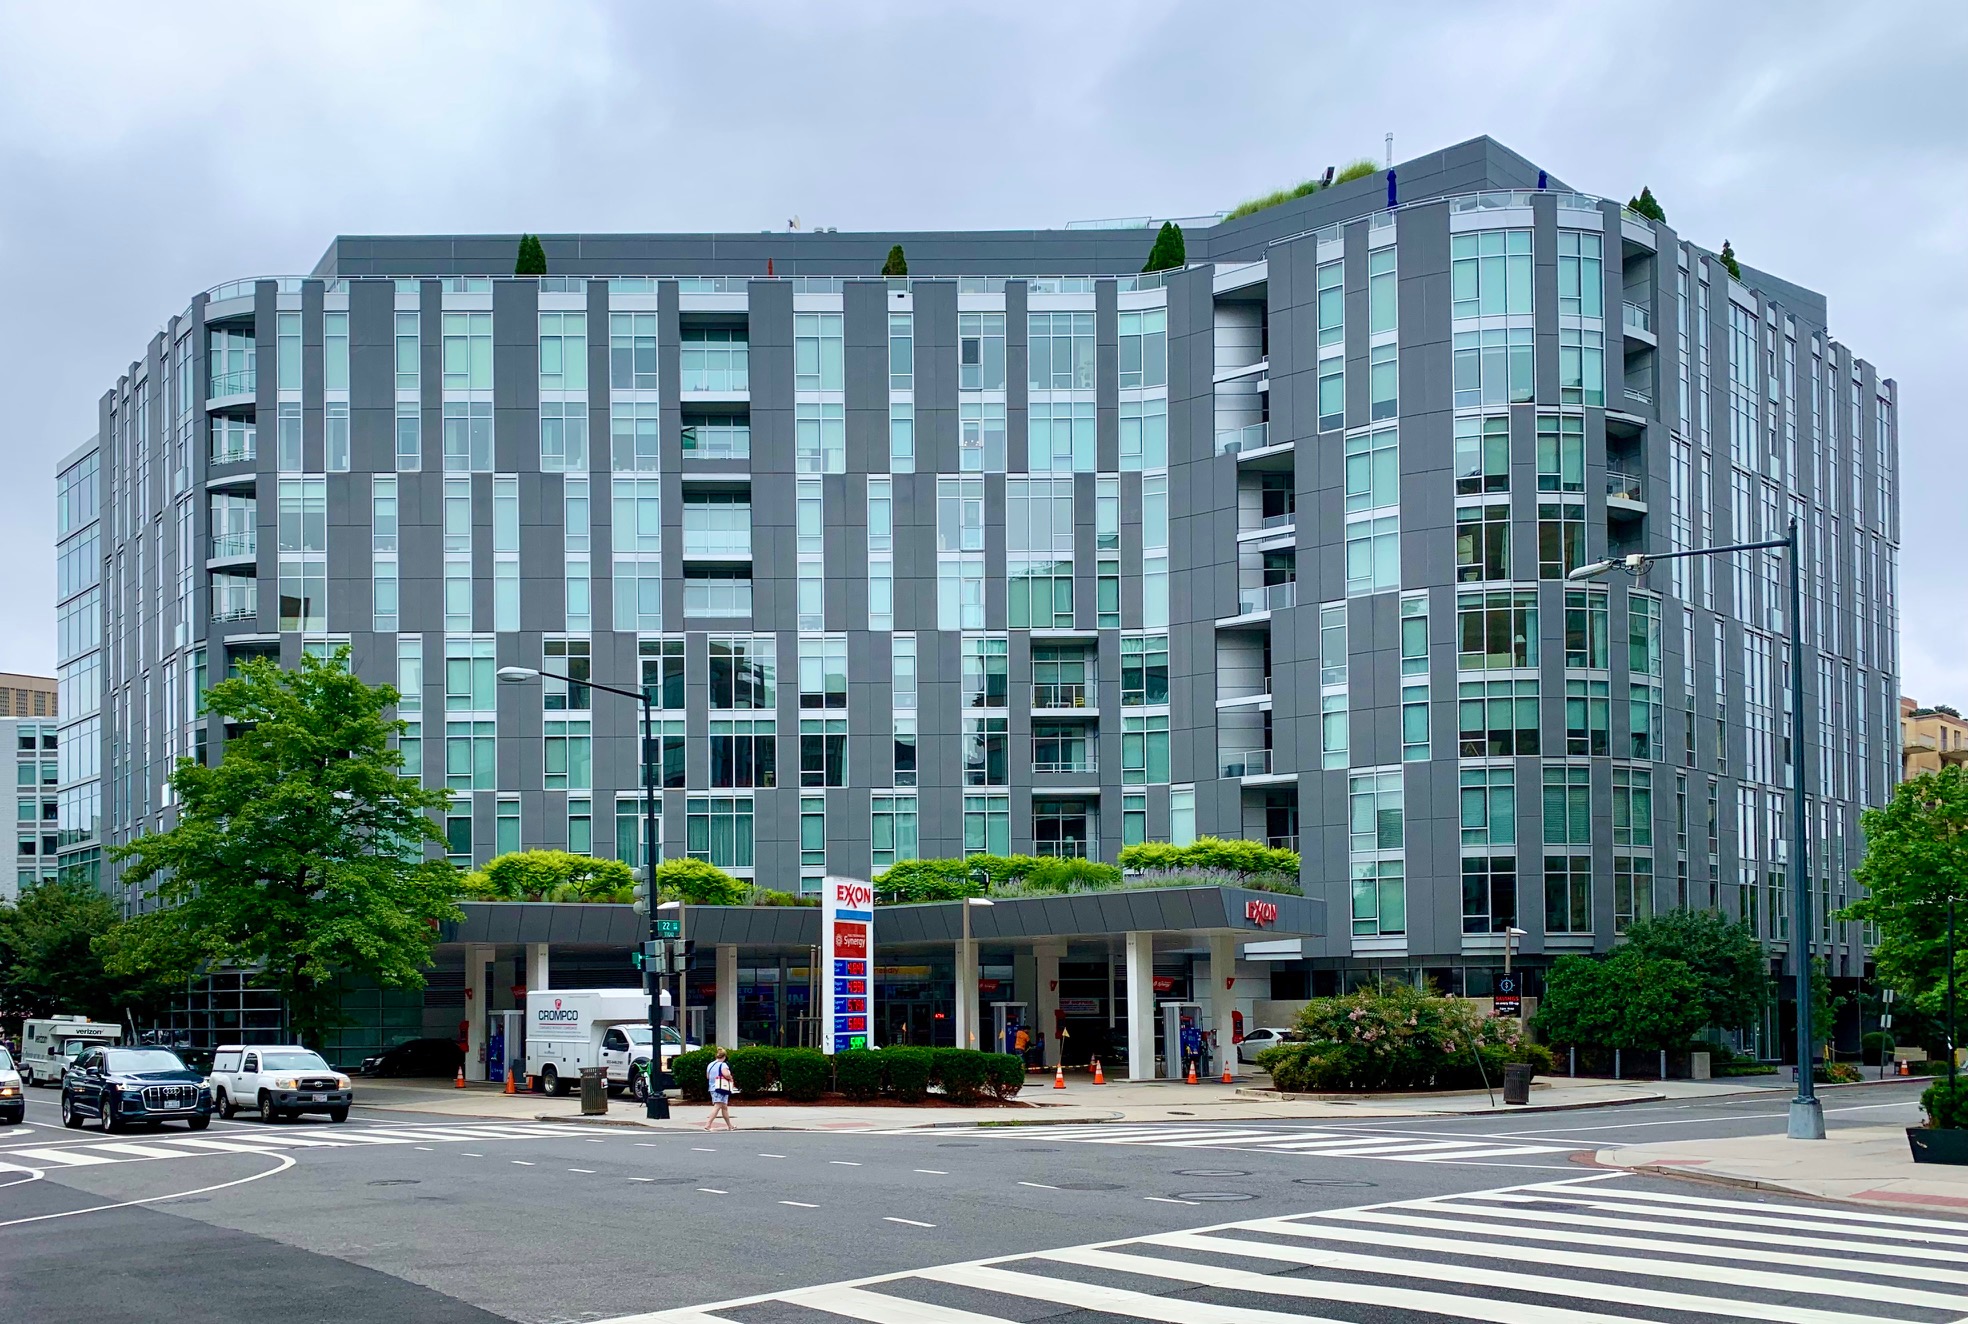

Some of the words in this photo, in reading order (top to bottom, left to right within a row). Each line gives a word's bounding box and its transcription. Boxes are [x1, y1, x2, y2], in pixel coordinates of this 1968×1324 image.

[837, 884, 871, 908] EXXON
[1246, 900, 1277, 927] EXXON
[662, 921, 670, 930] 22
[844, 935, 866, 948] Synergy
[538, 1010, 579, 1021] CROMPCO
